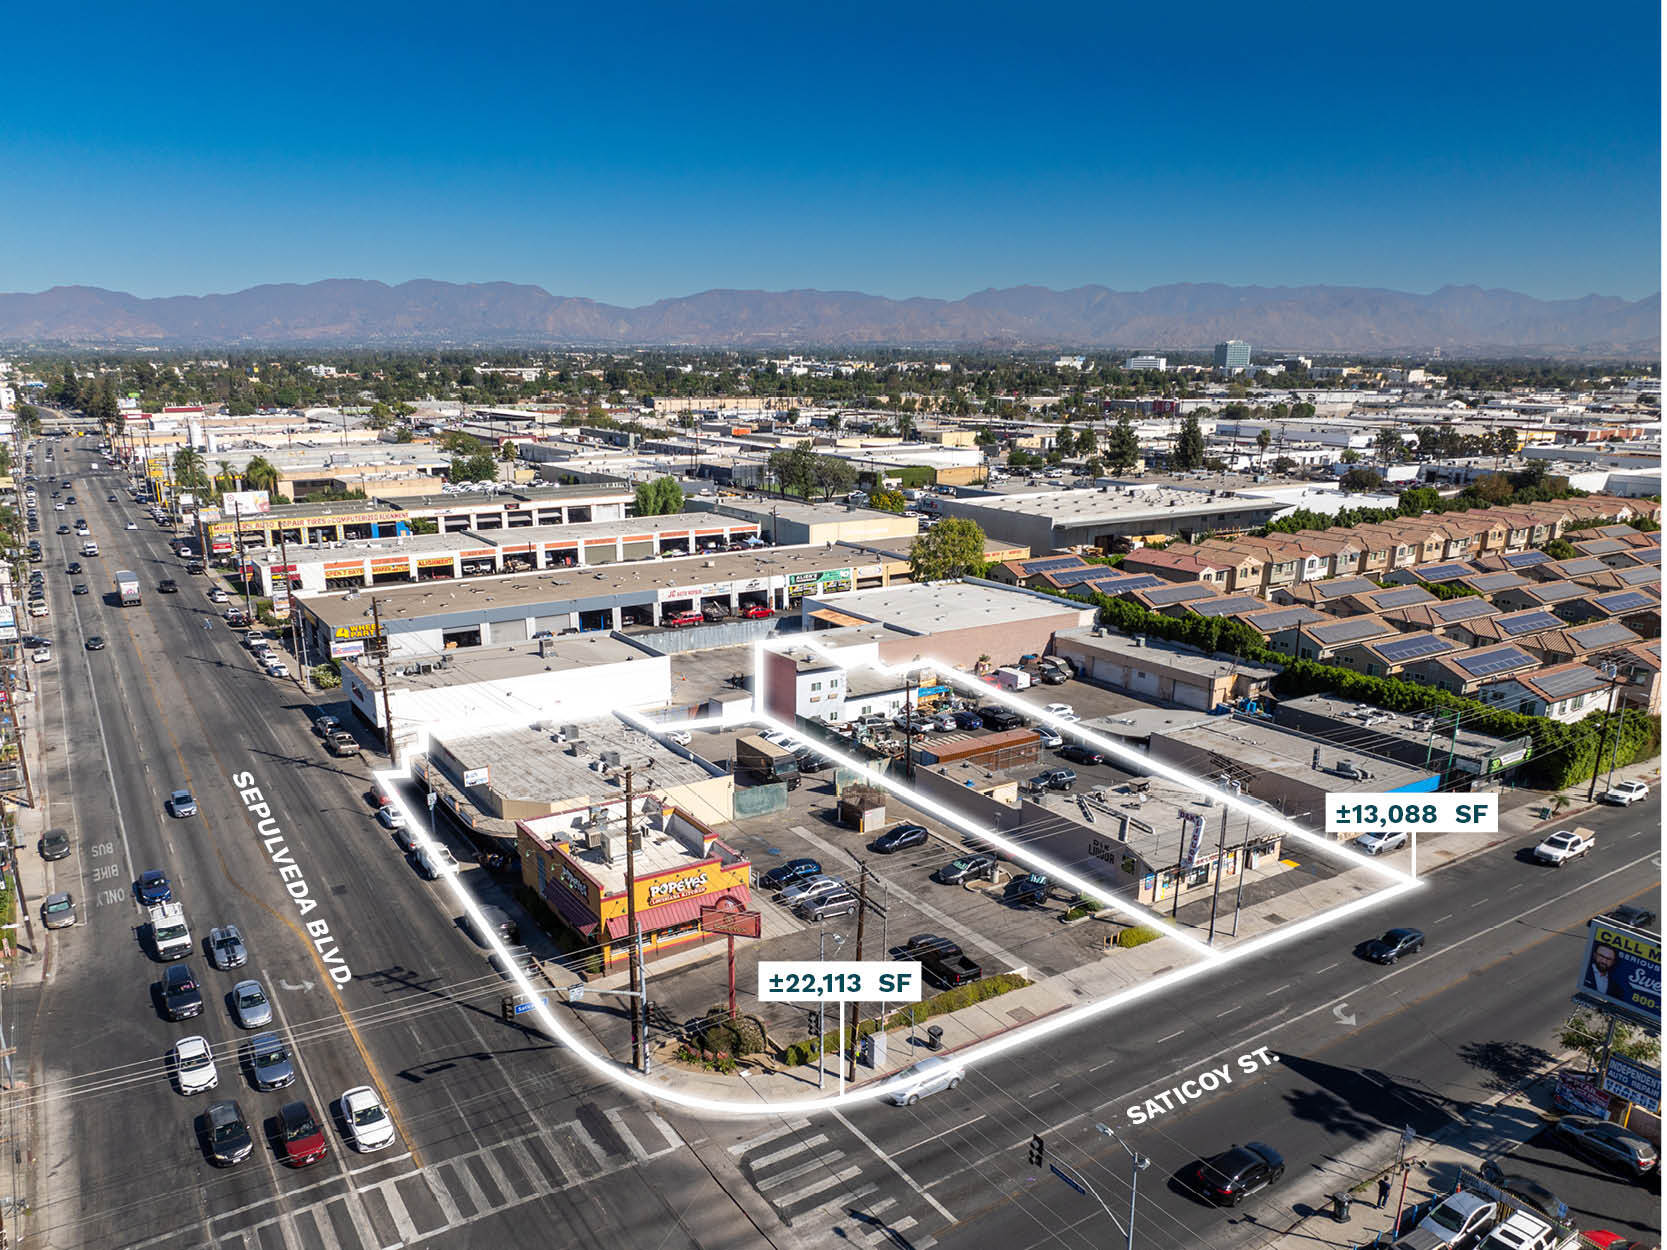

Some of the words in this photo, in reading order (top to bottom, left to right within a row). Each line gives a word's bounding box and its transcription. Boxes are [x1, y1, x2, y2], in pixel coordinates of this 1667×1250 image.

[256, 521, 274, 529] AUTO
[307, 517, 327, 525] TIRES
[418, 558, 452, 567] ALIGNMENT
[336, 627, 350, 638] 4
[91, 842, 114, 858] BUS
[1088, 843, 1115, 865] LIQUOR
[93, 864, 120, 882] BIKE
[96, 888, 126, 907] ONLY
[1600, 931, 1644, 955] CALL
[1607, 1070, 1629, 1084] AUTO
[1631, 1080, 1660, 1098] REPAIR
[1608, 1061, 1661, 1090] INDEPENDENT
